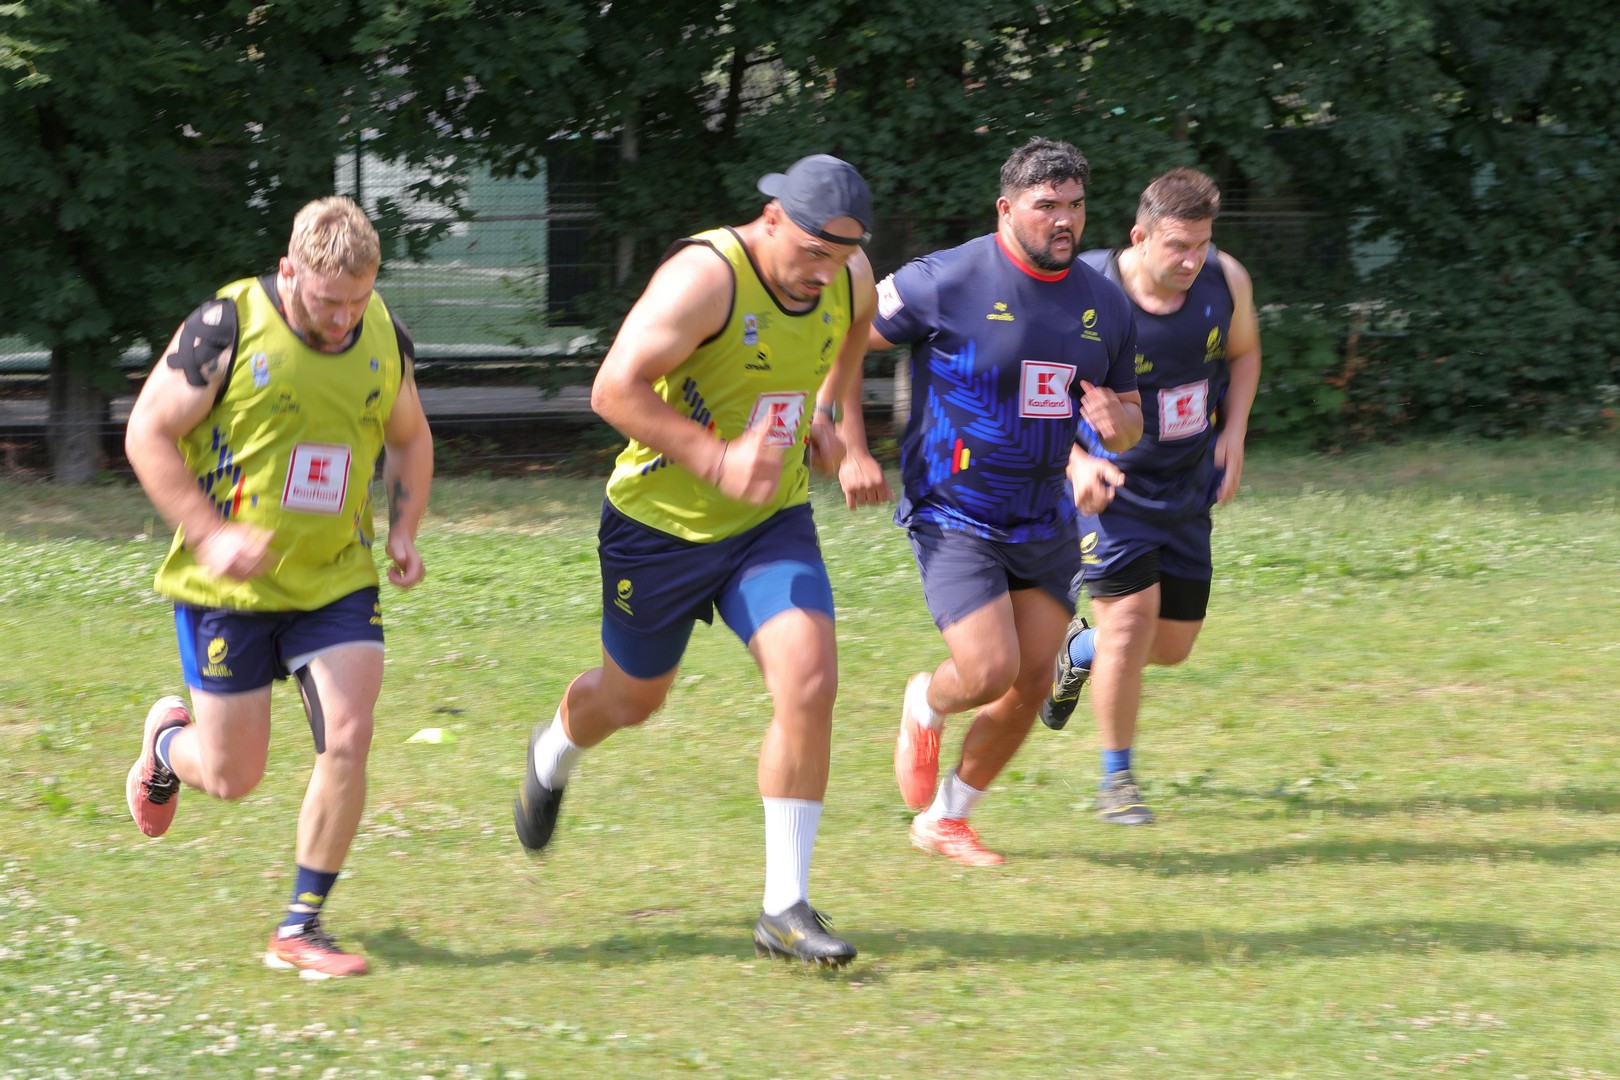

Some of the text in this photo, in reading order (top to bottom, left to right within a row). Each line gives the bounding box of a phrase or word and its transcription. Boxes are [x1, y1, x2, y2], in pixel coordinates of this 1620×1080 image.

[1038, 372, 1056, 394] K
[1027, 398, 1065, 408] Kaufland
[1176, 394, 1195, 417] K
